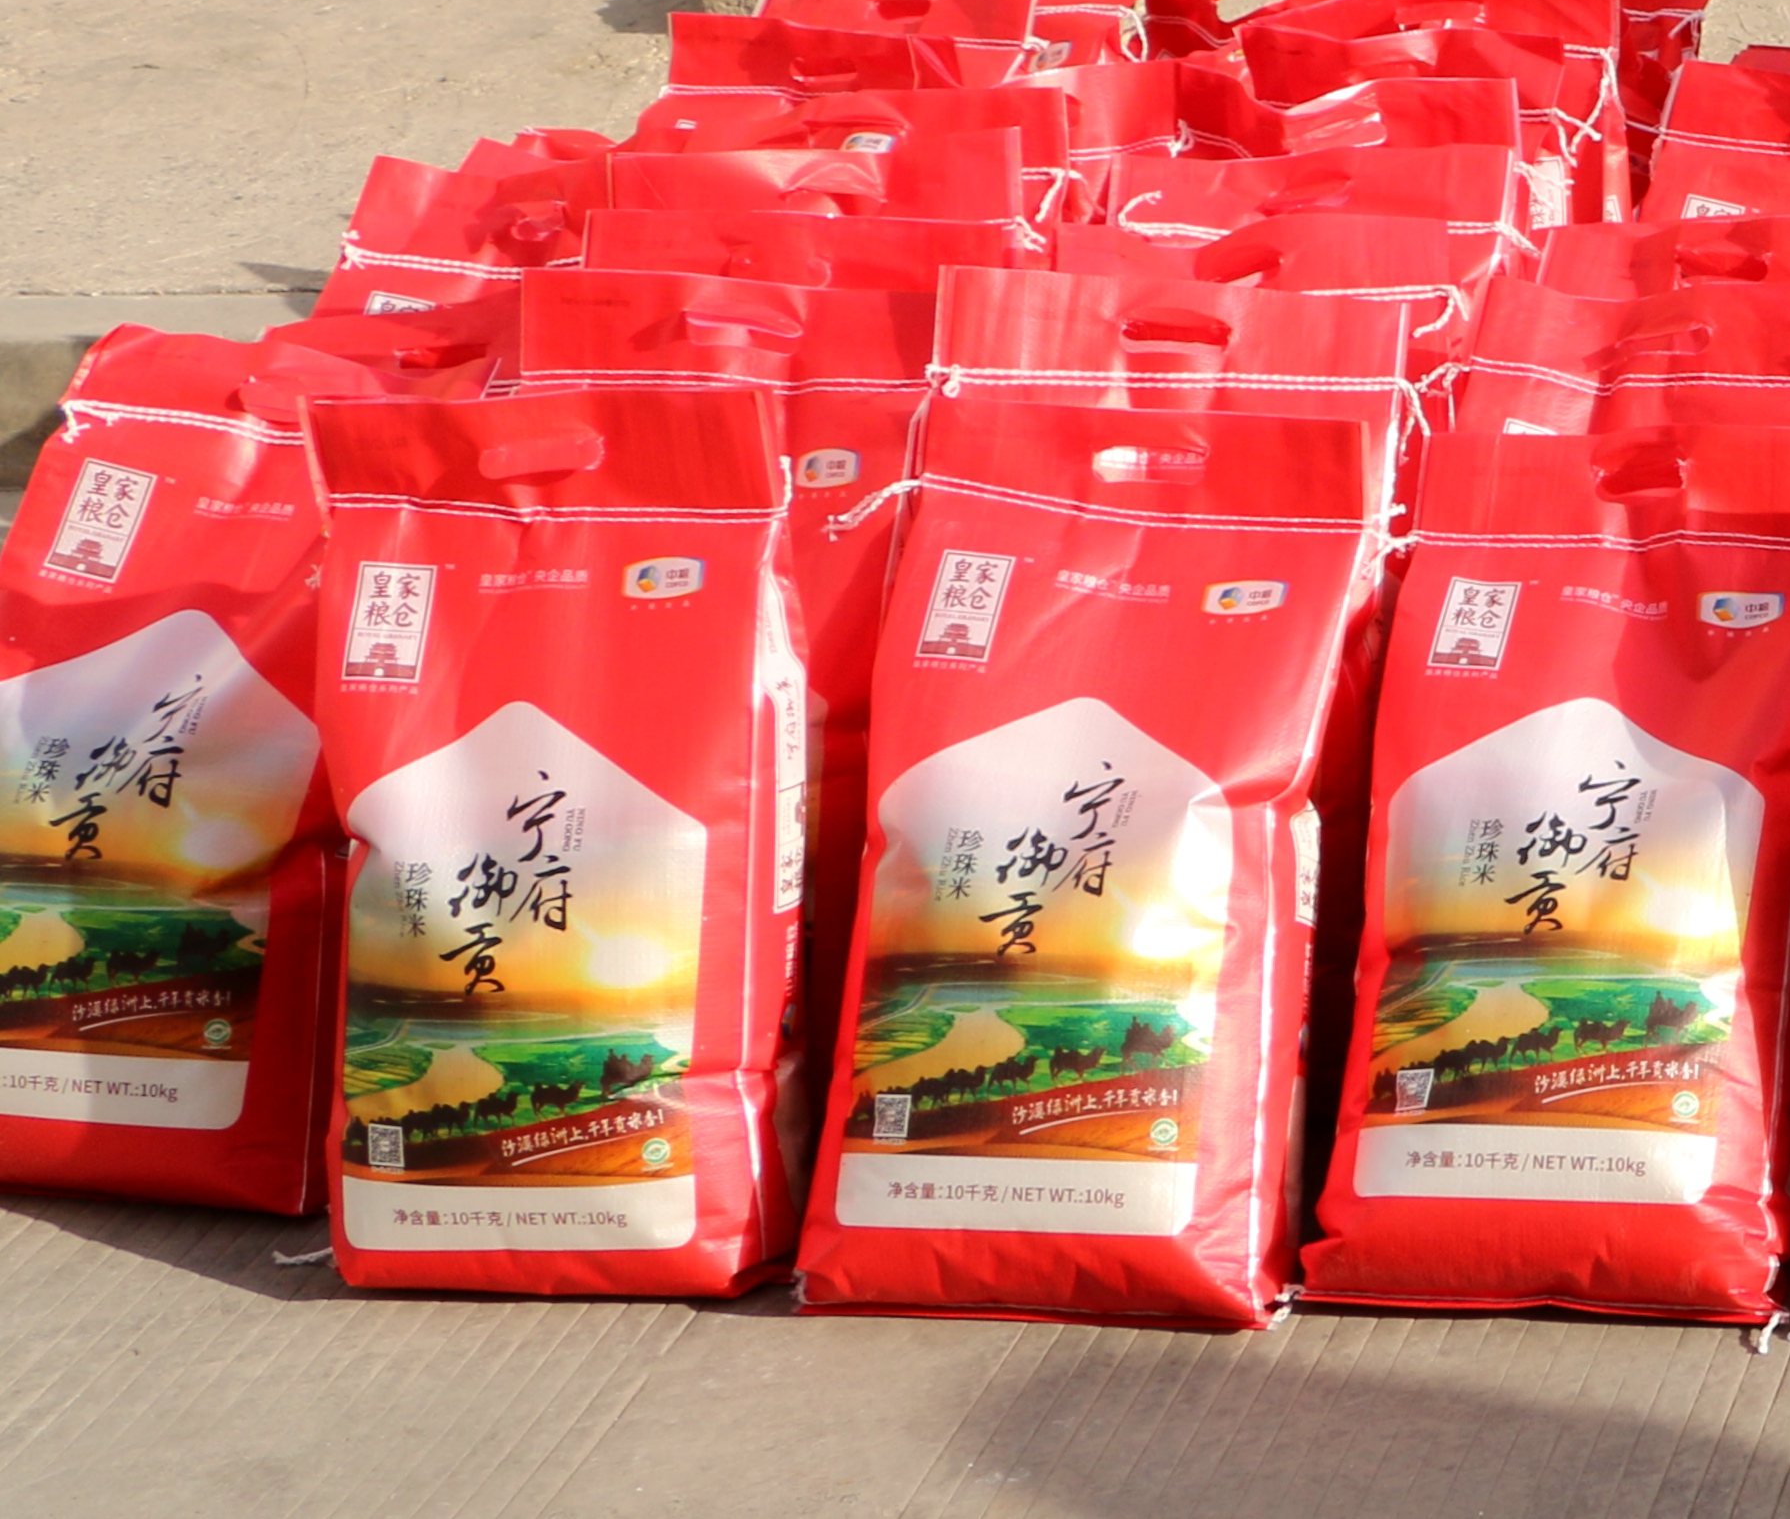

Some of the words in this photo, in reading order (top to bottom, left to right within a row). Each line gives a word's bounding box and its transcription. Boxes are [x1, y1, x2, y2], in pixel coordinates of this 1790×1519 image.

[86, 470, 139, 501] 皇家
[78, 498, 131, 529] 粮仓
[368, 570, 421, 600] 皇家
[948, 558, 999, 585] 皇家
[941, 586, 993, 611] 粮仓
[1462, 586, 1505, 608] 皇家
[364, 601, 418, 628] 粮仓
[1452, 608, 1502, 630] 粮仓
[27, 738, 71, 804] 珍珠米
[946, 830, 984, 899] 珍珠米
[1471, 818, 1504, 885] 珍珠米
[405, 861, 433, 937] 珍珠米
[72, 1079, 103, 1094] NET
[1532, 1153, 1566, 1171] NET
[1011, 1186, 1046, 1202] NET
[516, 1211, 548, 1225] NET
